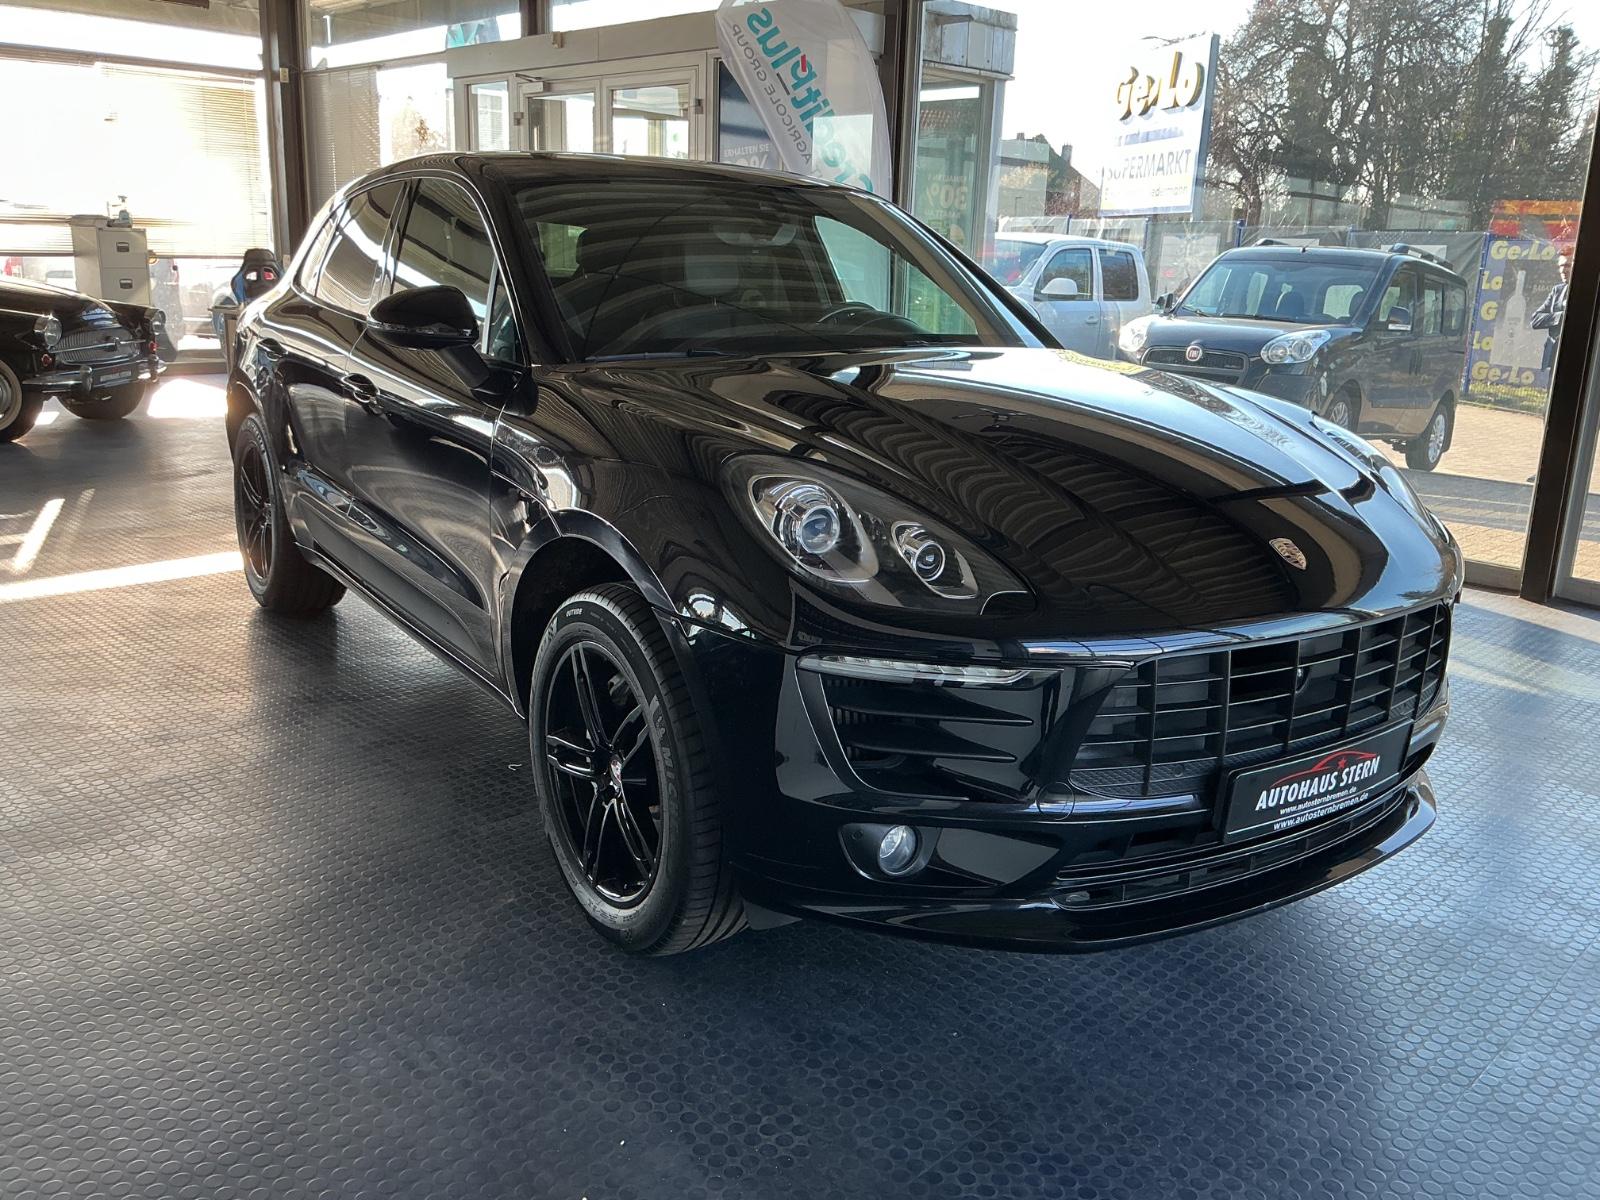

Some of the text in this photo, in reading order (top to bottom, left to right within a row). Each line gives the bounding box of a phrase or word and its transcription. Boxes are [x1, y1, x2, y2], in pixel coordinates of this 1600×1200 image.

[1491, 240, 1556, 260] Ge-Lo
[1472, 361, 1535, 384] Ge-Lo
[1255, 755, 1381, 811] AUTOHAUS STERN
[1273, 792, 1369, 831] www.autosternbremen.de
[1279, 786, 1357, 815] www.autosternbremen.de
